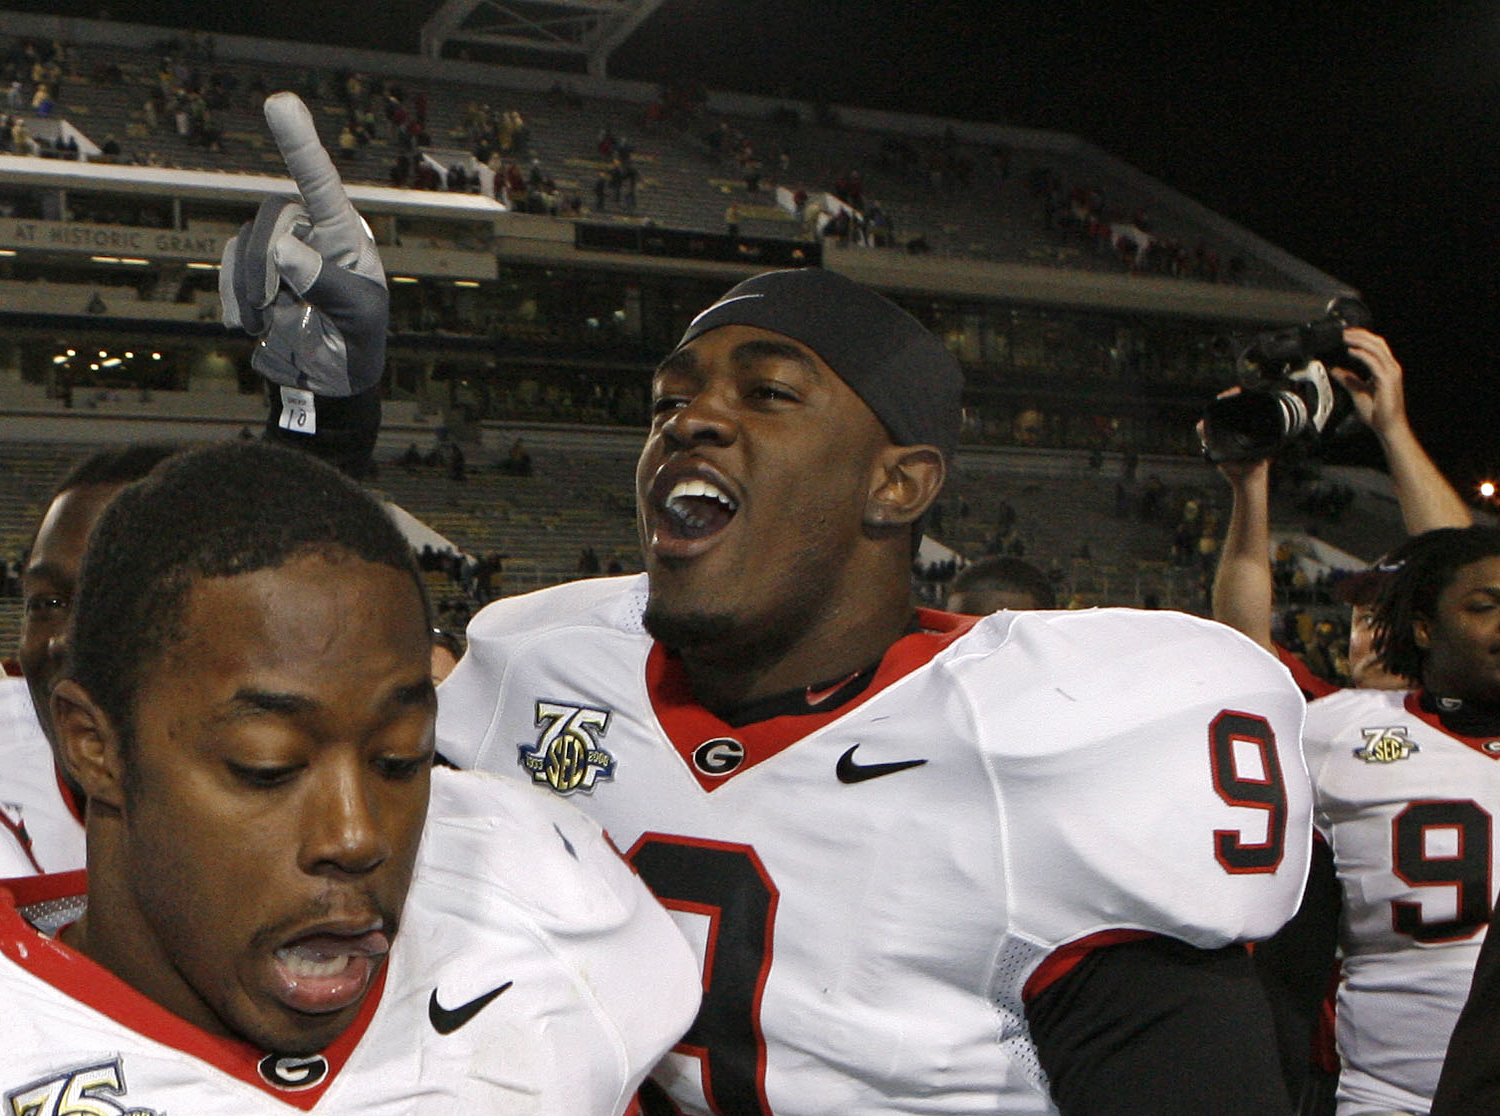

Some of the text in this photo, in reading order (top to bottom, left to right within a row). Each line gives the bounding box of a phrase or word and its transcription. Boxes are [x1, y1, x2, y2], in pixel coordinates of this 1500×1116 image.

[15, 223, 36, 241] AT
[50, 226, 142, 249] HISTORIC
[156, 233, 217, 254] GRANT
[534, 701, 610, 788] 75
[549, 734, 585, 790] SEC
[1208, 710, 1288, 876] 9
[1392, 799, 1492, 943] 9
